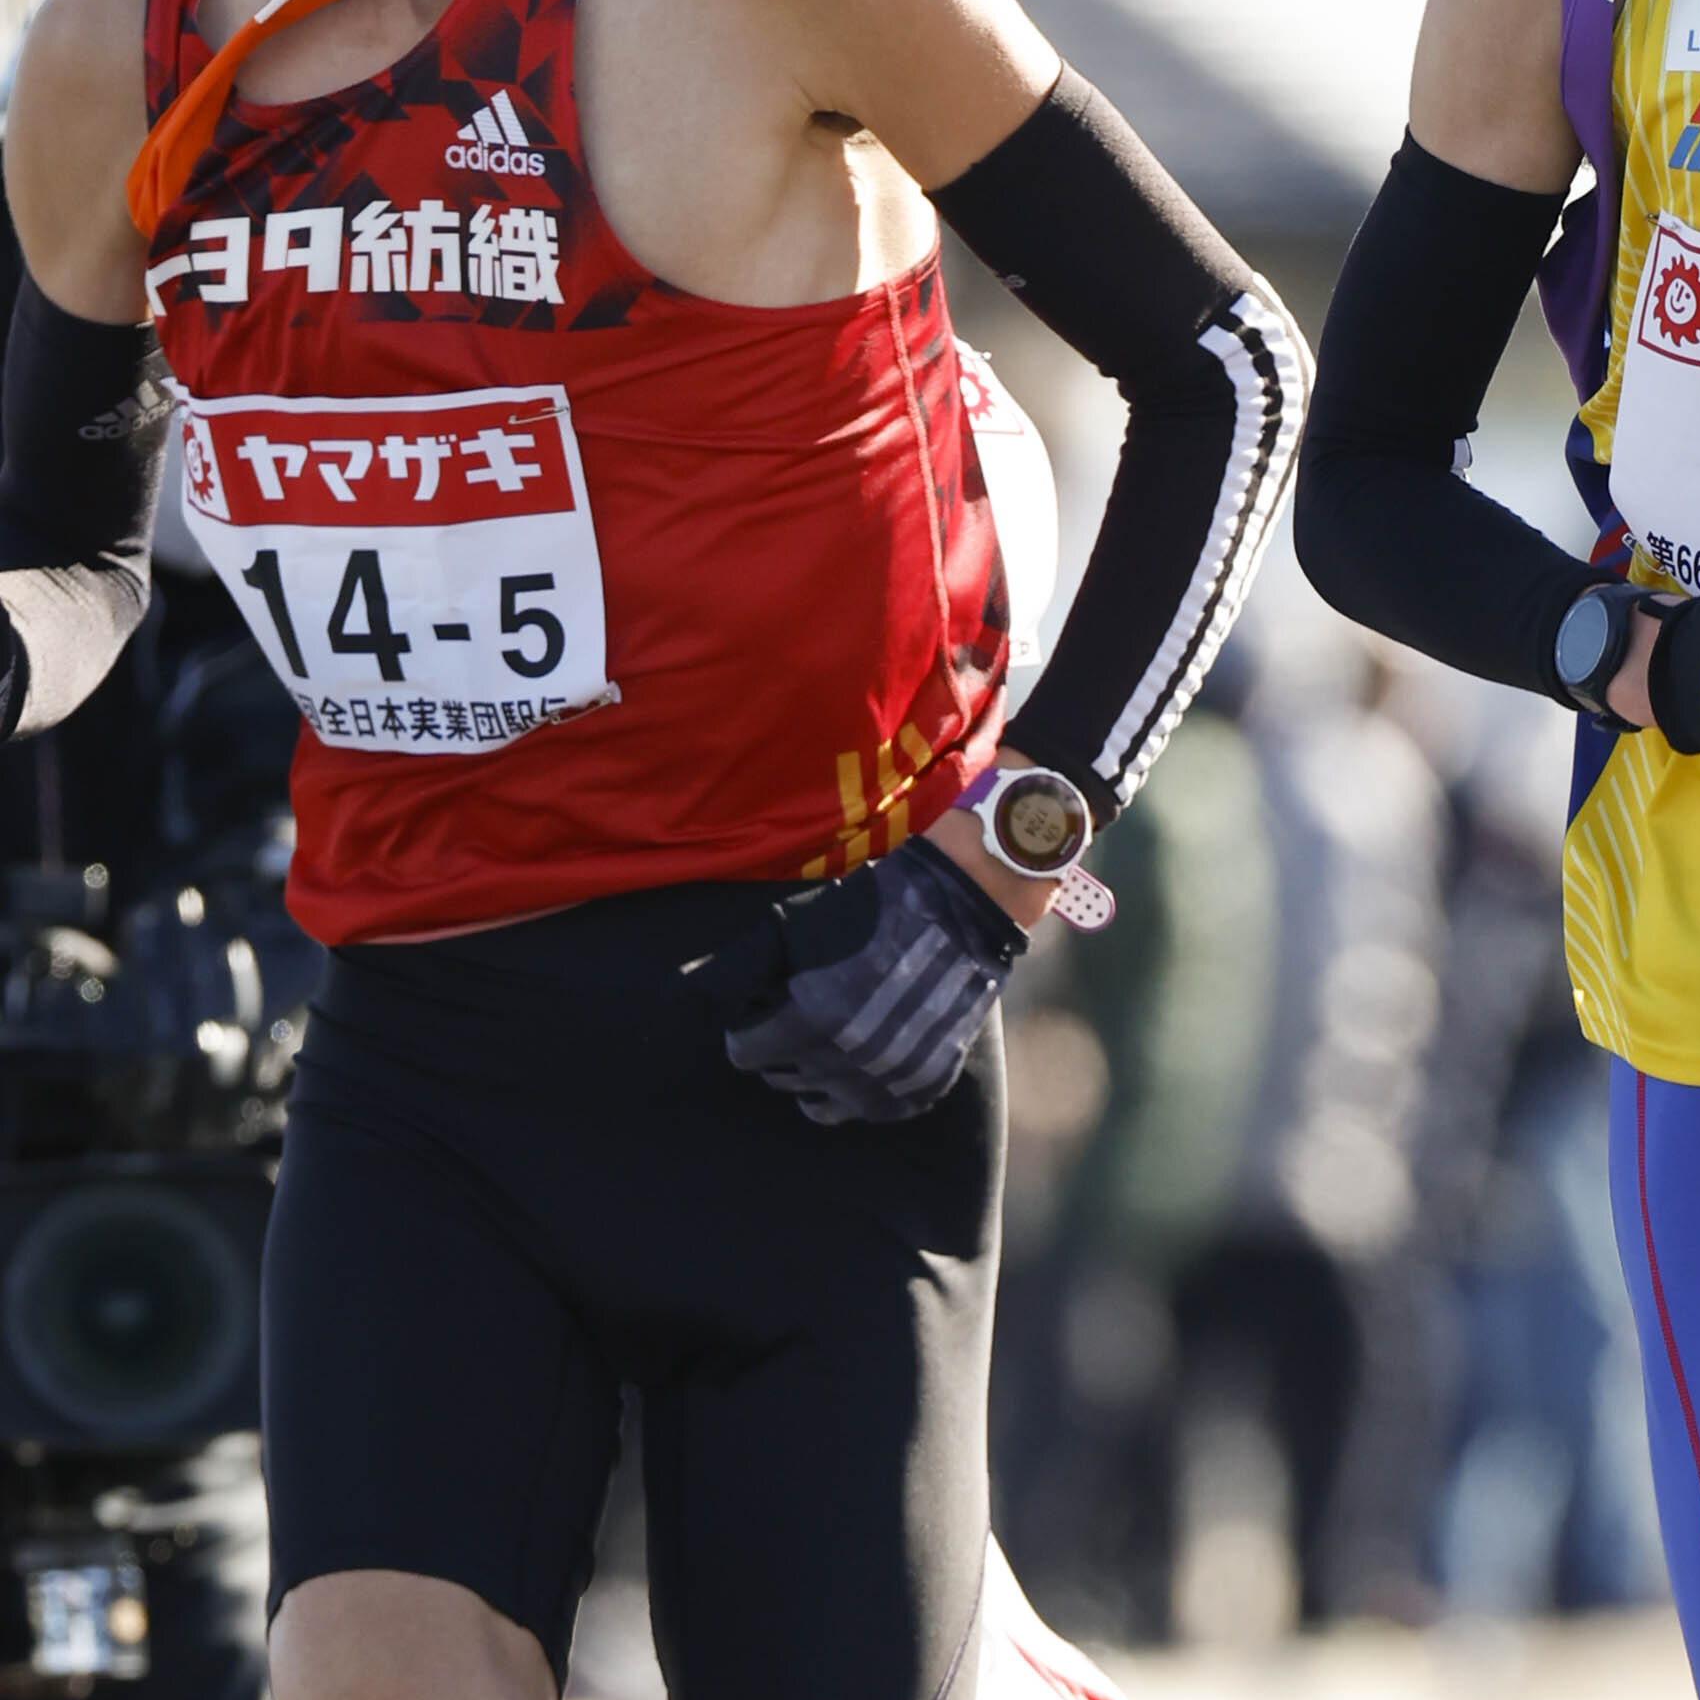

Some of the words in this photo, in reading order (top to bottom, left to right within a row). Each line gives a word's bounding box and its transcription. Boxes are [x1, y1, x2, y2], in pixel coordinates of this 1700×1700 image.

[445, 141, 545, 176] adidas
[236, 427, 543, 503] ヤマザキ
